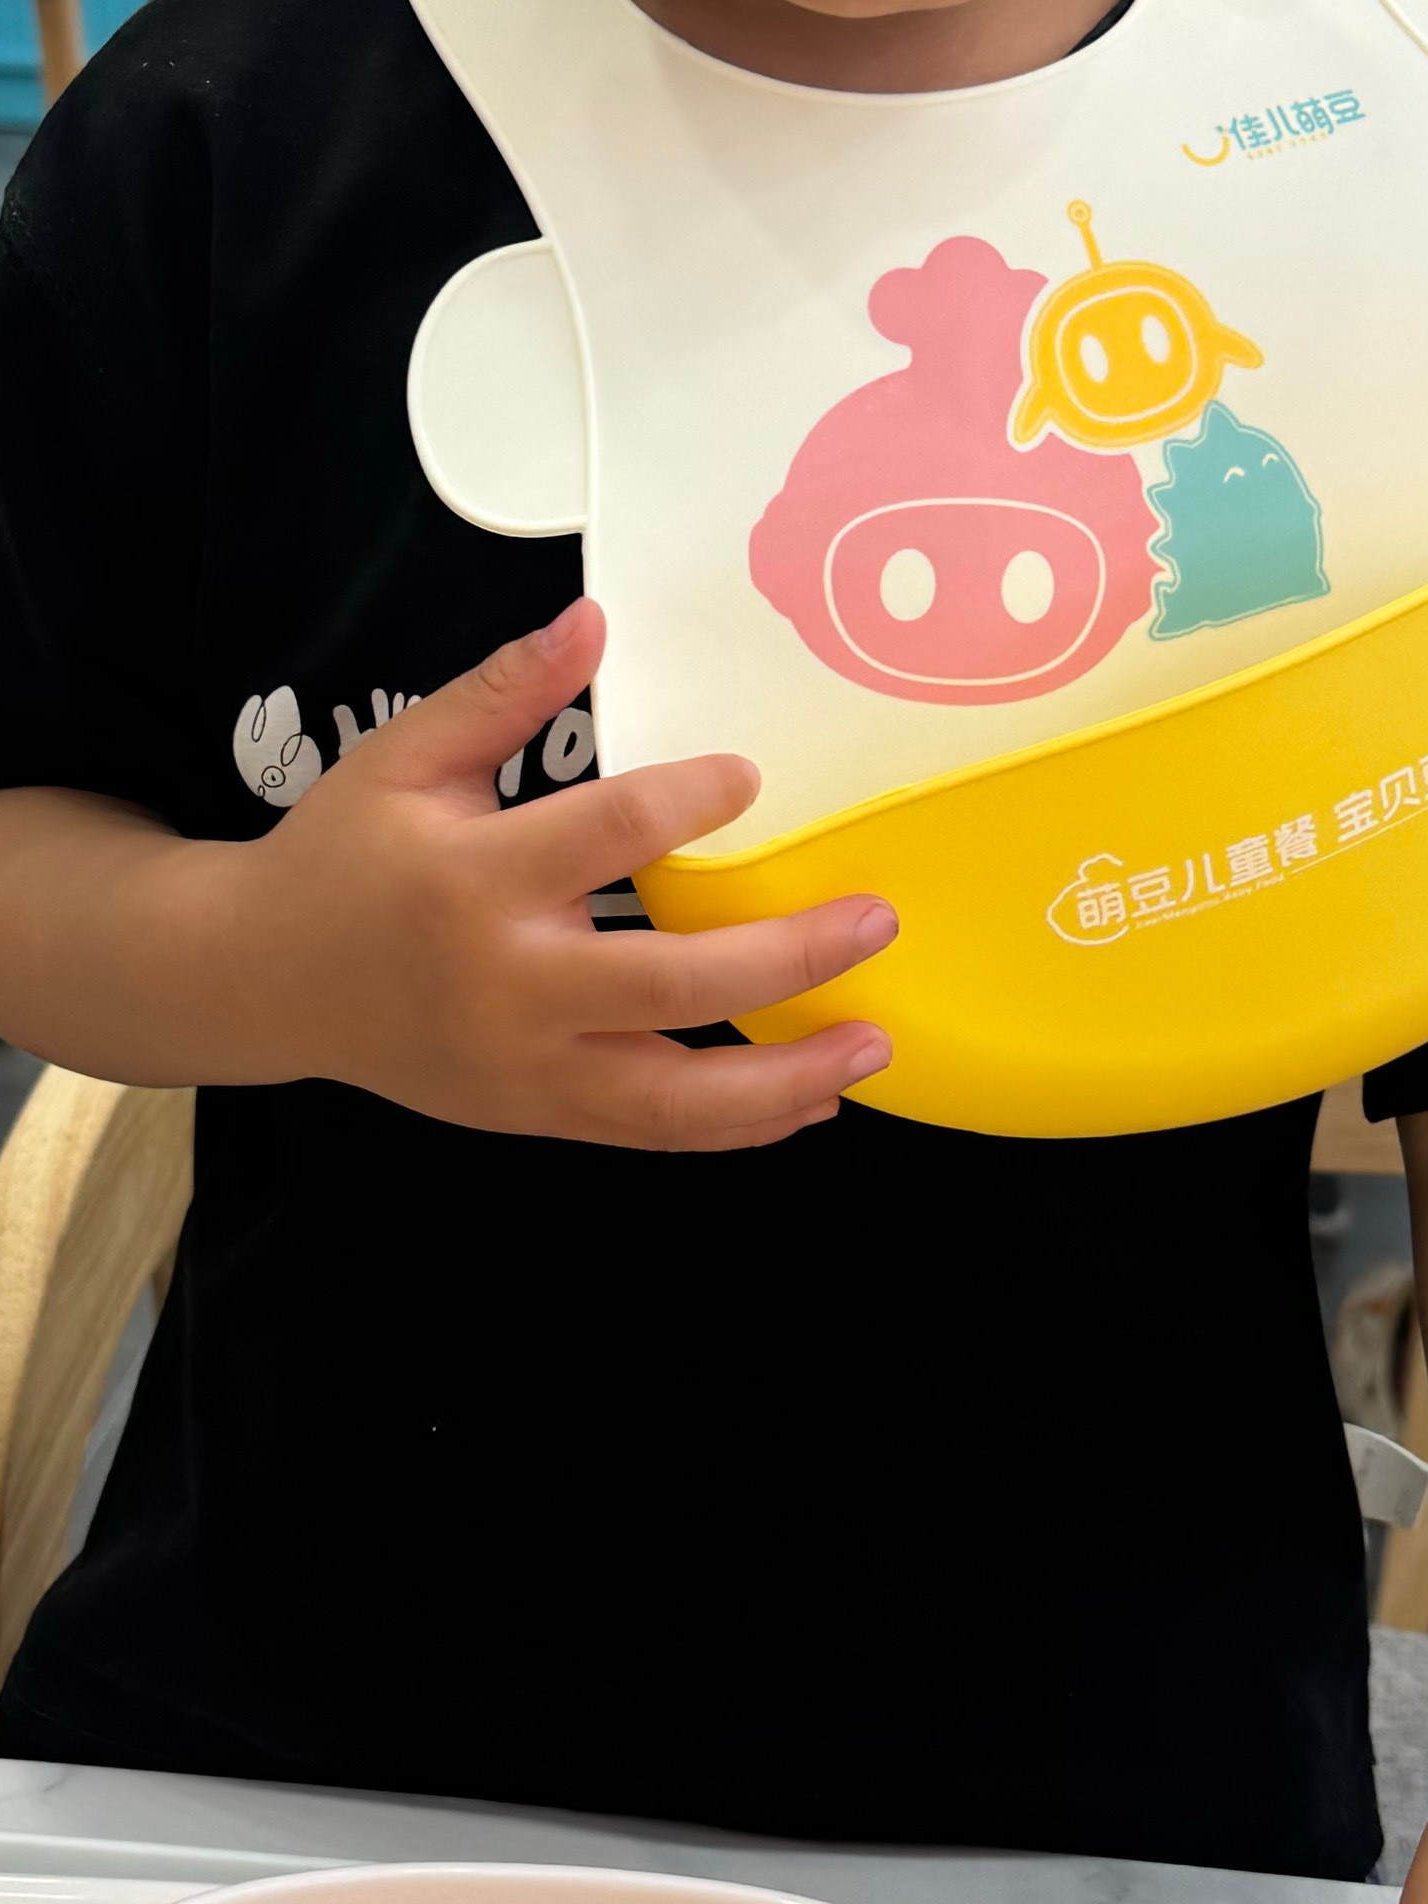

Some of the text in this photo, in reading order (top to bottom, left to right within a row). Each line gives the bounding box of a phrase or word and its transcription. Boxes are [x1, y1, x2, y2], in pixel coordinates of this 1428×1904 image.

[1229, 89, 1366, 151] 佳儿萌豆
[1077, 814, 1319, 929] 萌豆儿童餐
